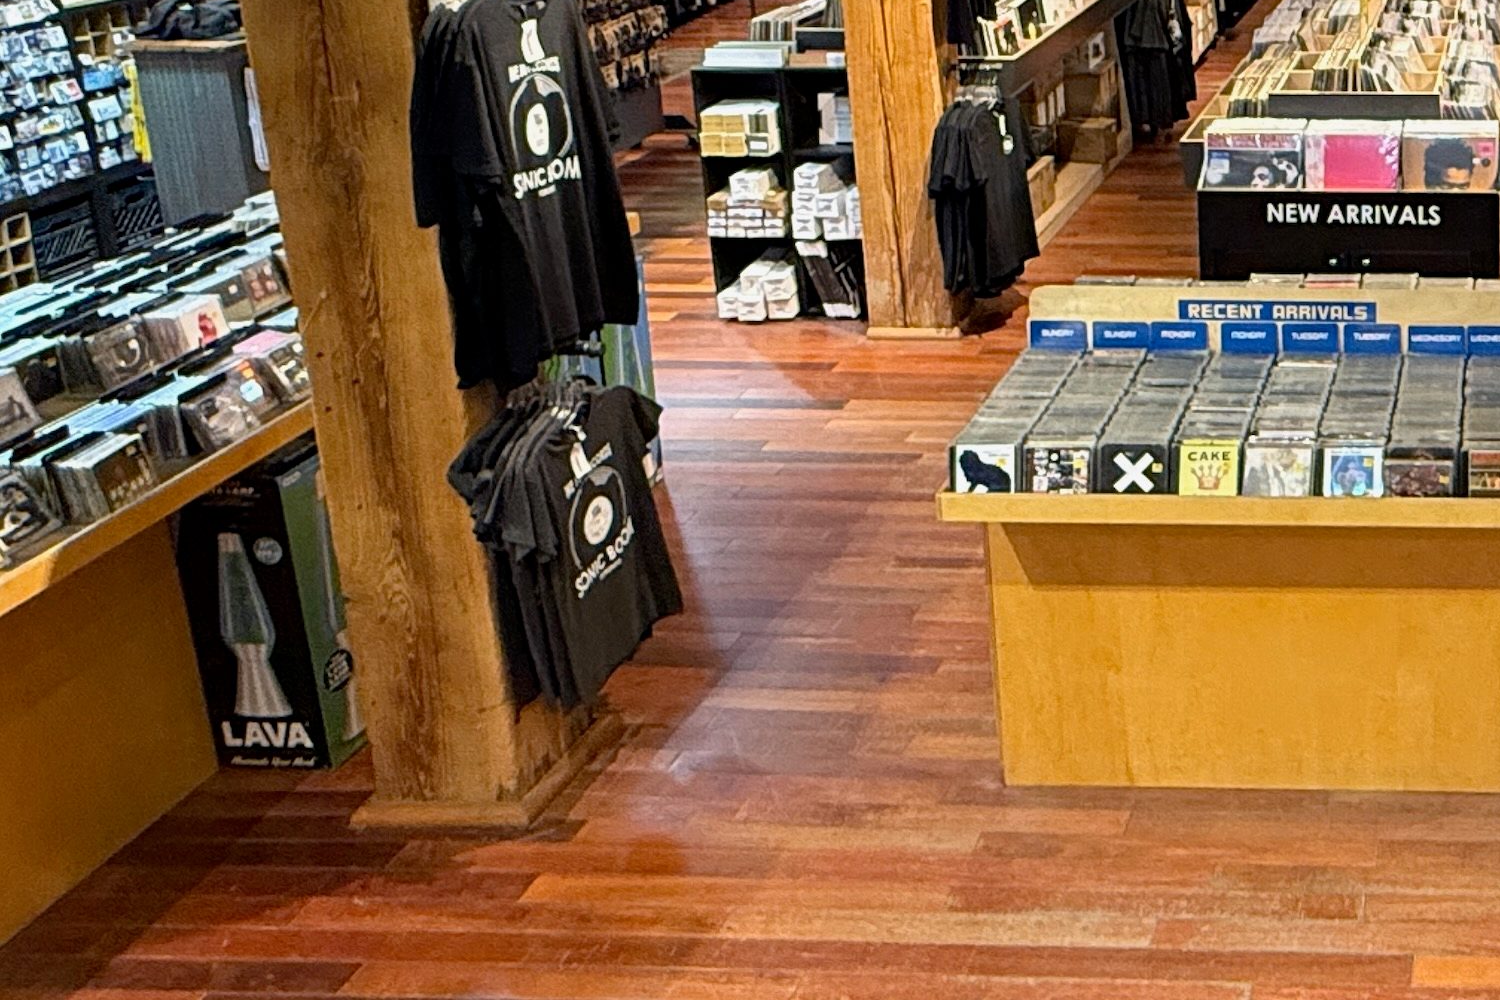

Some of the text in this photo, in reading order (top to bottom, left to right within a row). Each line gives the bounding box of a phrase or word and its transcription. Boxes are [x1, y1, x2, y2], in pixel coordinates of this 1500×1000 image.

[513, 167, 547, 200] SNIC
[1266, 203, 1441, 226] NEW ARRIVALS
[1187, 304, 1368, 321] RECENT ARRIVALS
[1291, 332, 1329, 341] TUESDAY
[1353, 332, 1391, 341] TUESDAY
[1187, 451, 1231, 461] CAKE
[221, 721, 314, 749] LAVA
